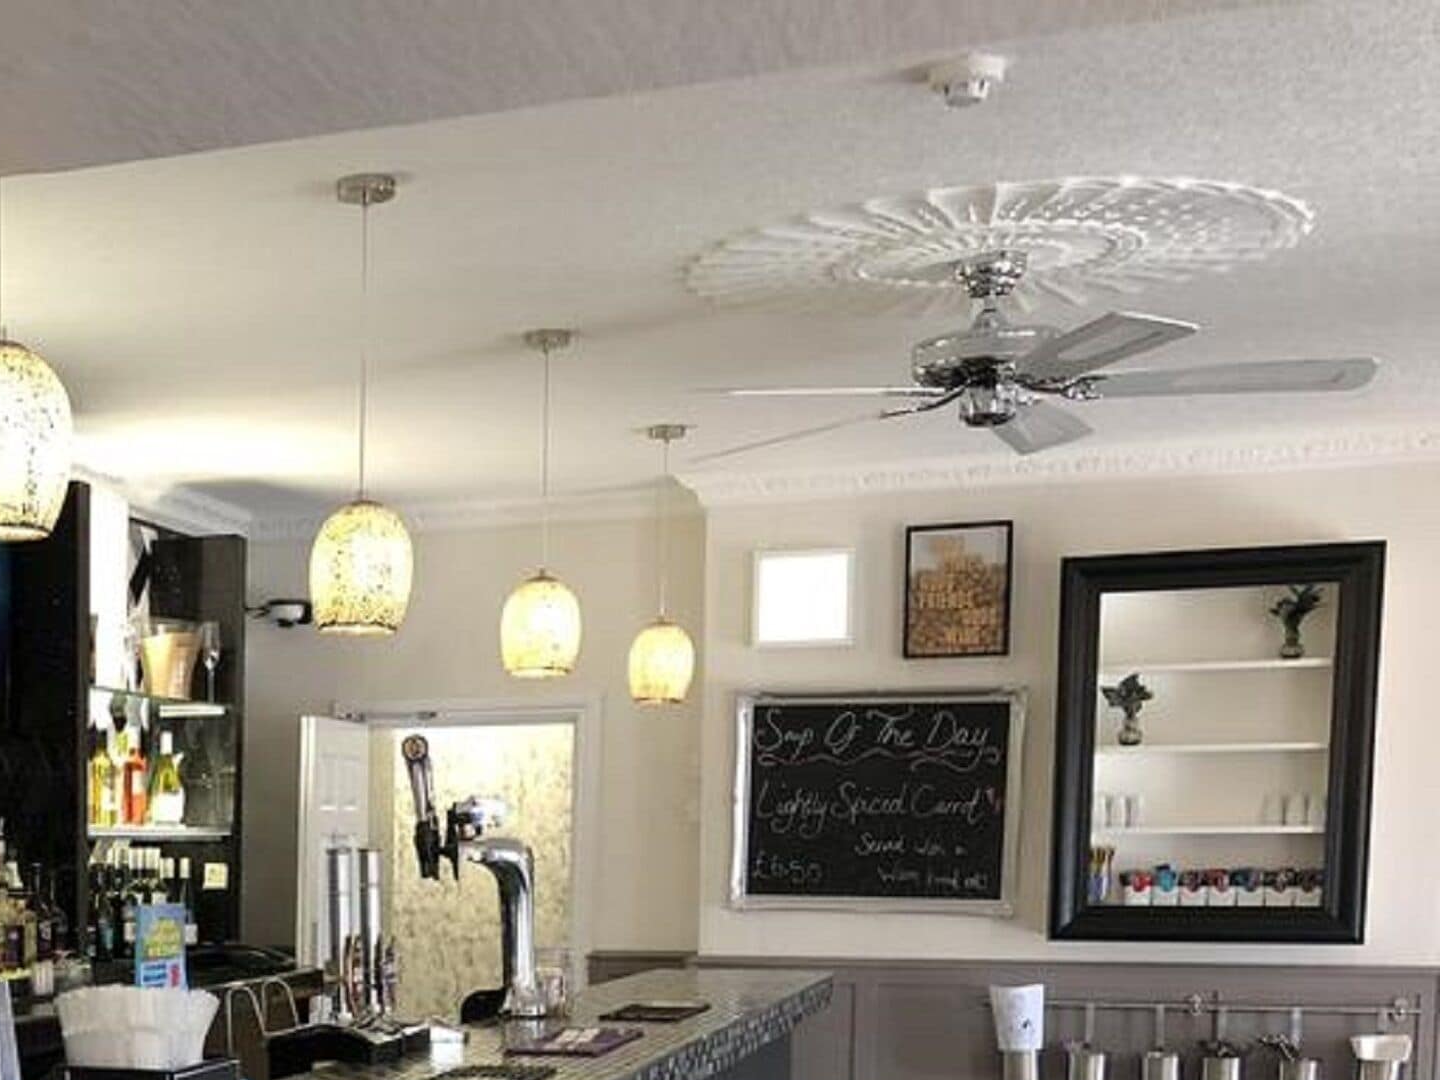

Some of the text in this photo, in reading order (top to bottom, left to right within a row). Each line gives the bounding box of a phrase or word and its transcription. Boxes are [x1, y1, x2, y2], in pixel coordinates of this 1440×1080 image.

[863, 705, 915, 746] The
[922, 709, 992, 773] Day
[829, 780, 908, 825] Spiced
